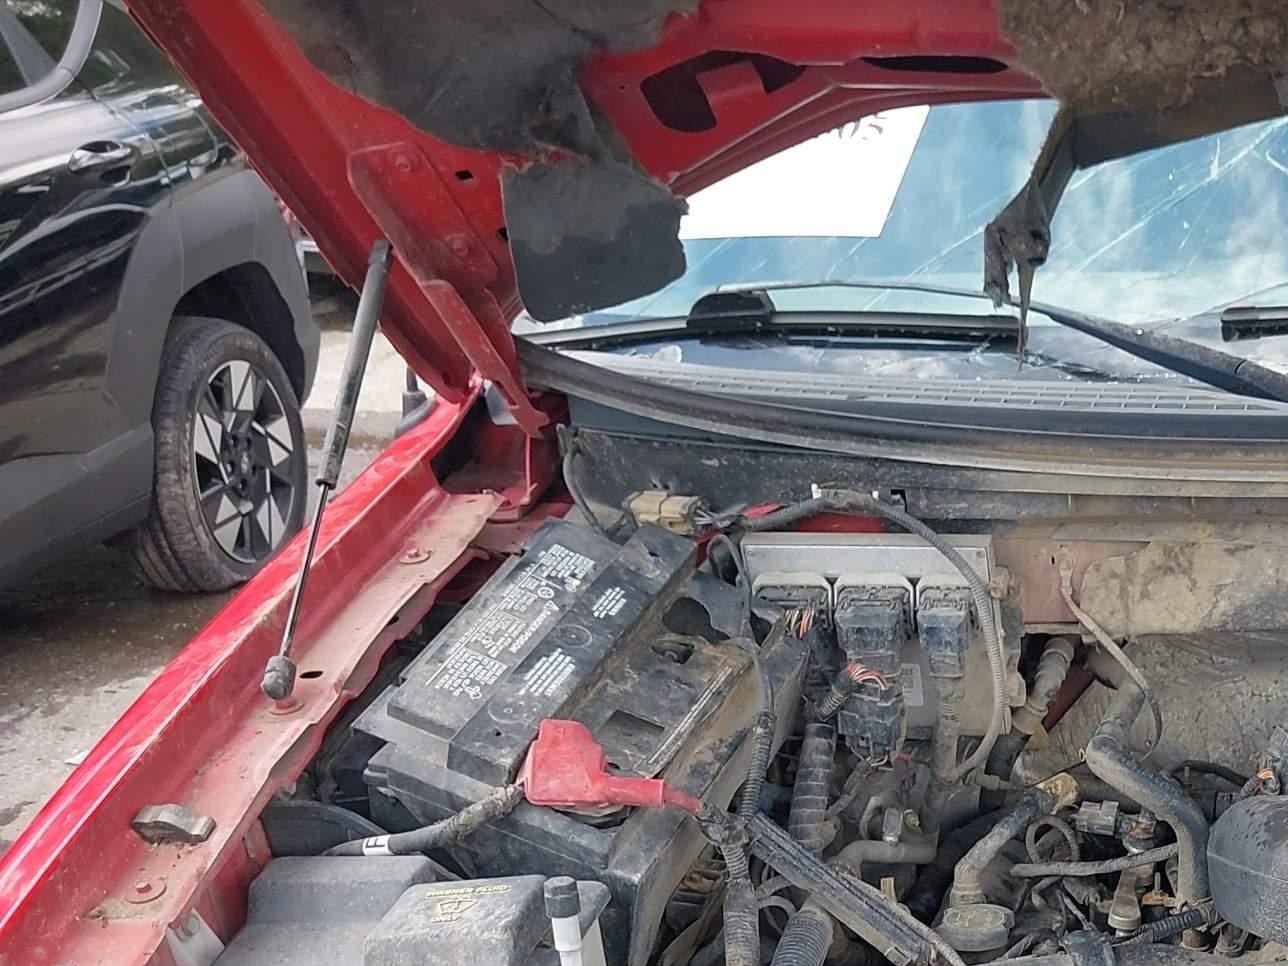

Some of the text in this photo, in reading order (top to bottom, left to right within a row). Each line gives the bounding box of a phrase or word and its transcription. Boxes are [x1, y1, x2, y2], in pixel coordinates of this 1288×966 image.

[426, 884, 512, 898] WASHER FLUID
[430, 913, 462, 924] ONLY
